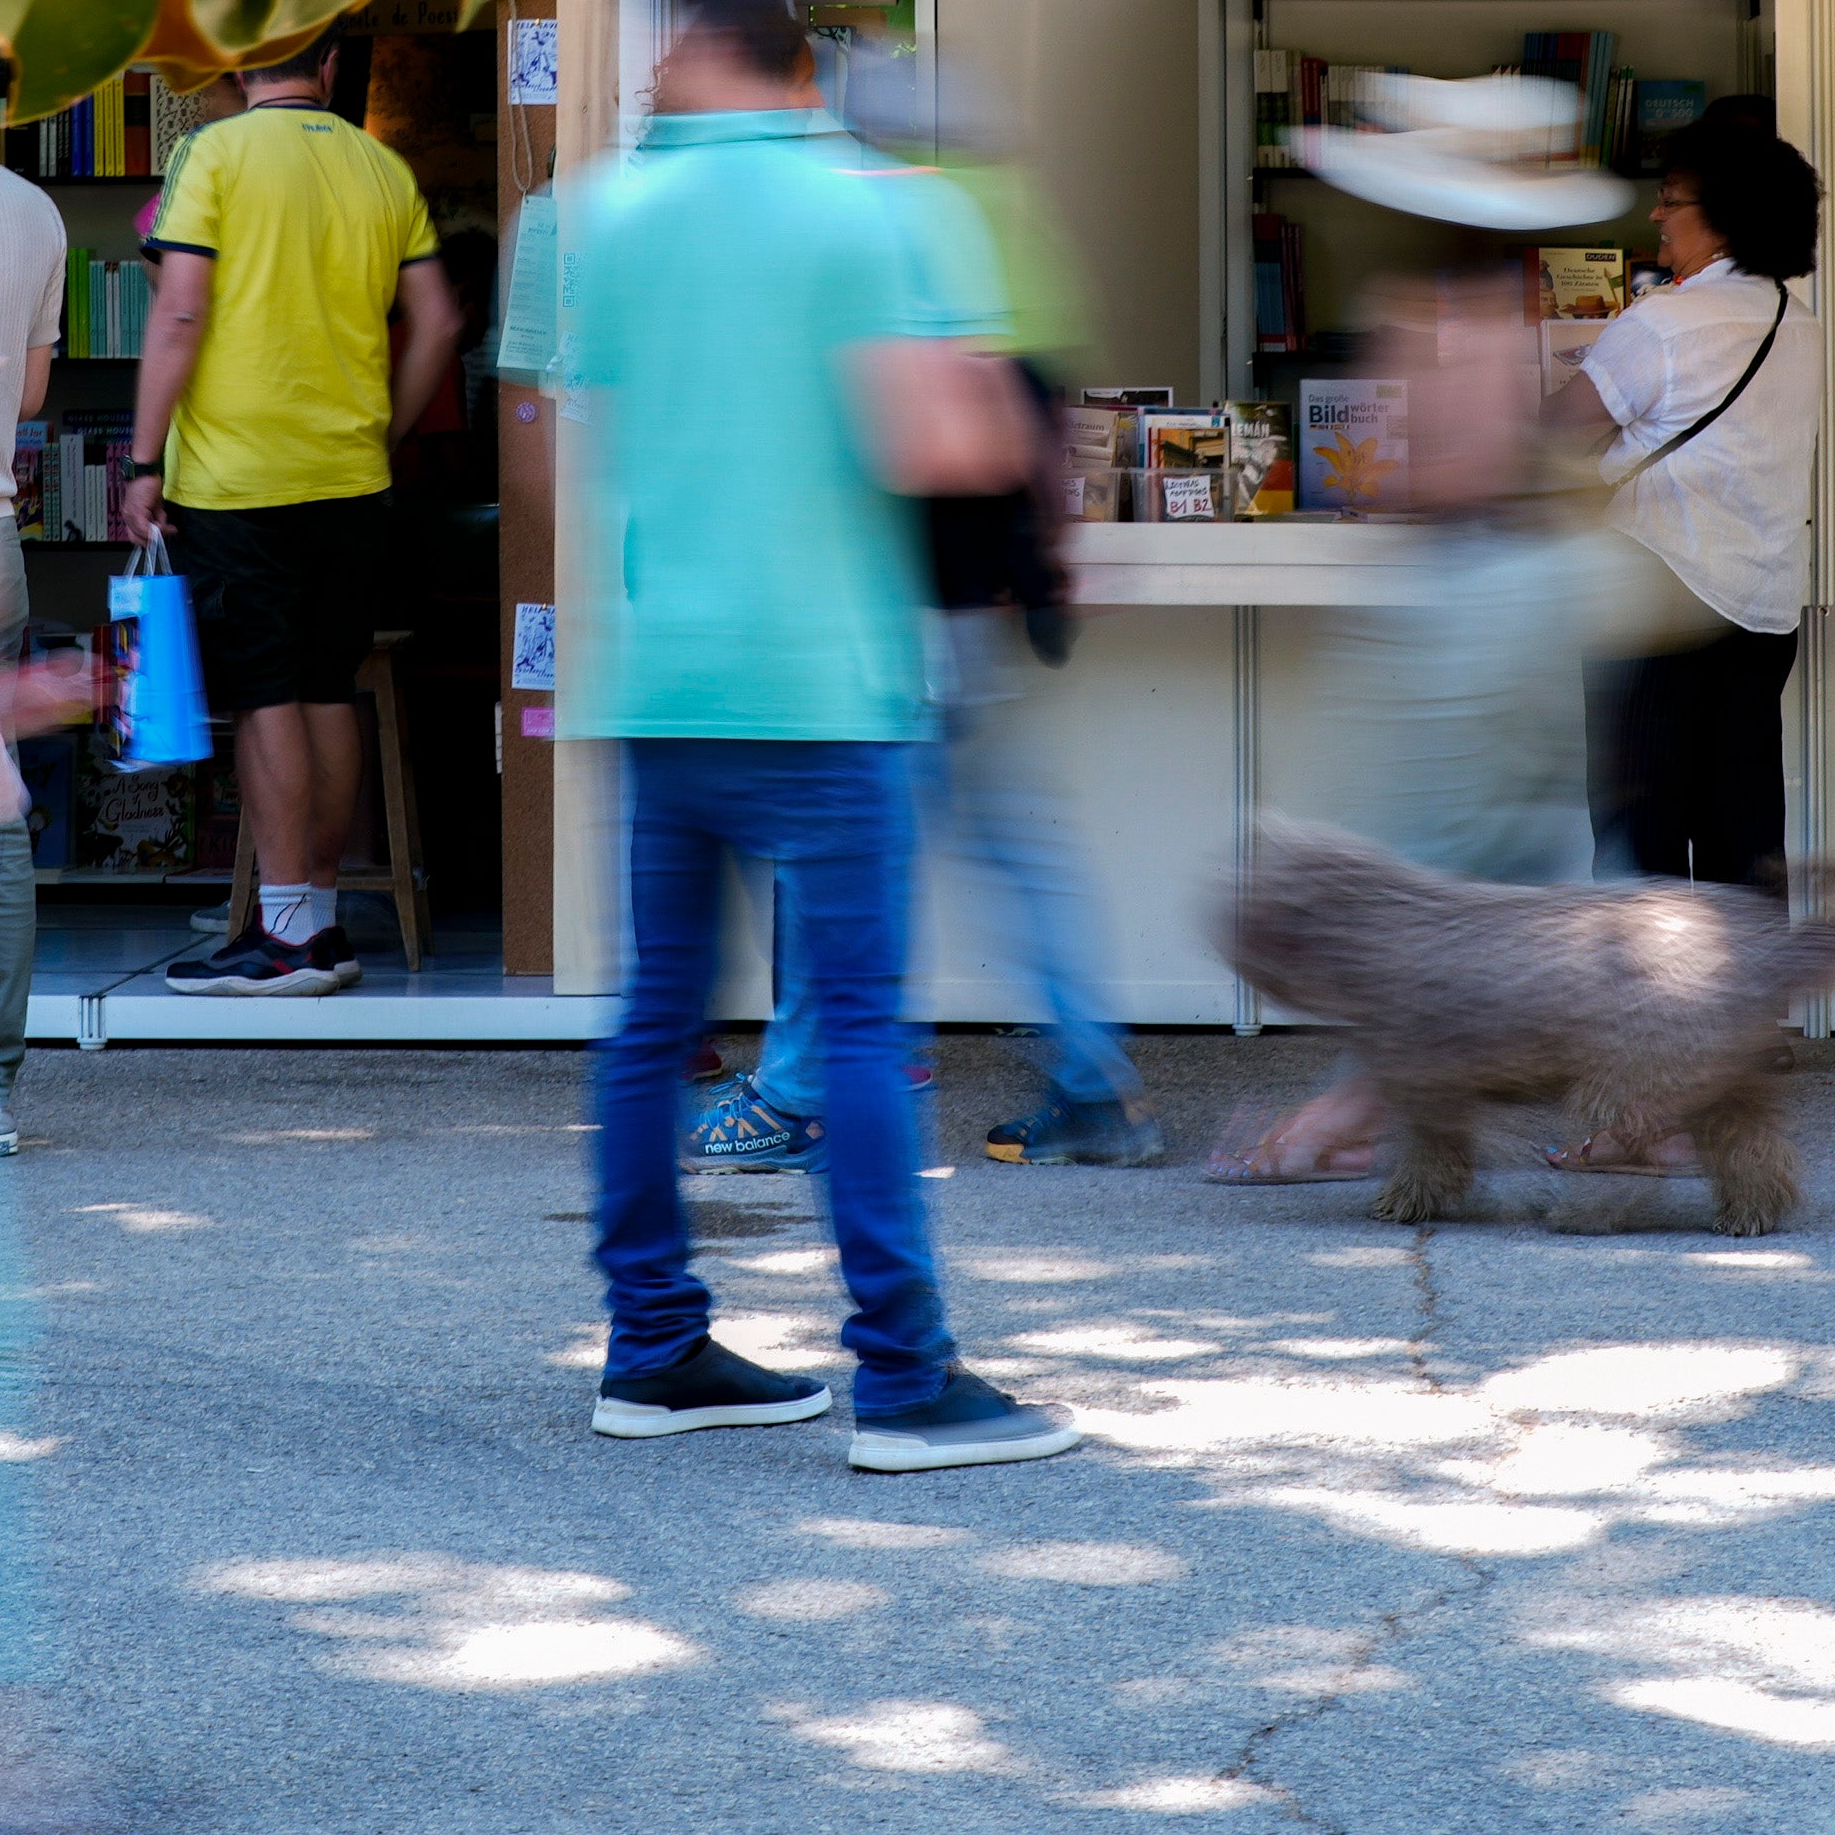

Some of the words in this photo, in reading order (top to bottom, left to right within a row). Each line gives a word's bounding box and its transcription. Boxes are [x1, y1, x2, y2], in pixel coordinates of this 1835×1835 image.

[1307, 394, 1324, 403] Das
[1309, 404, 1350, 423] Bild
[1350, 402, 1390, 413] wörter
[1350, 413, 1378, 423] buch
[1193, 499, 1213, 512] B2
[126, 775, 163, 801] Song
[104, 798, 166, 823] Gladness
